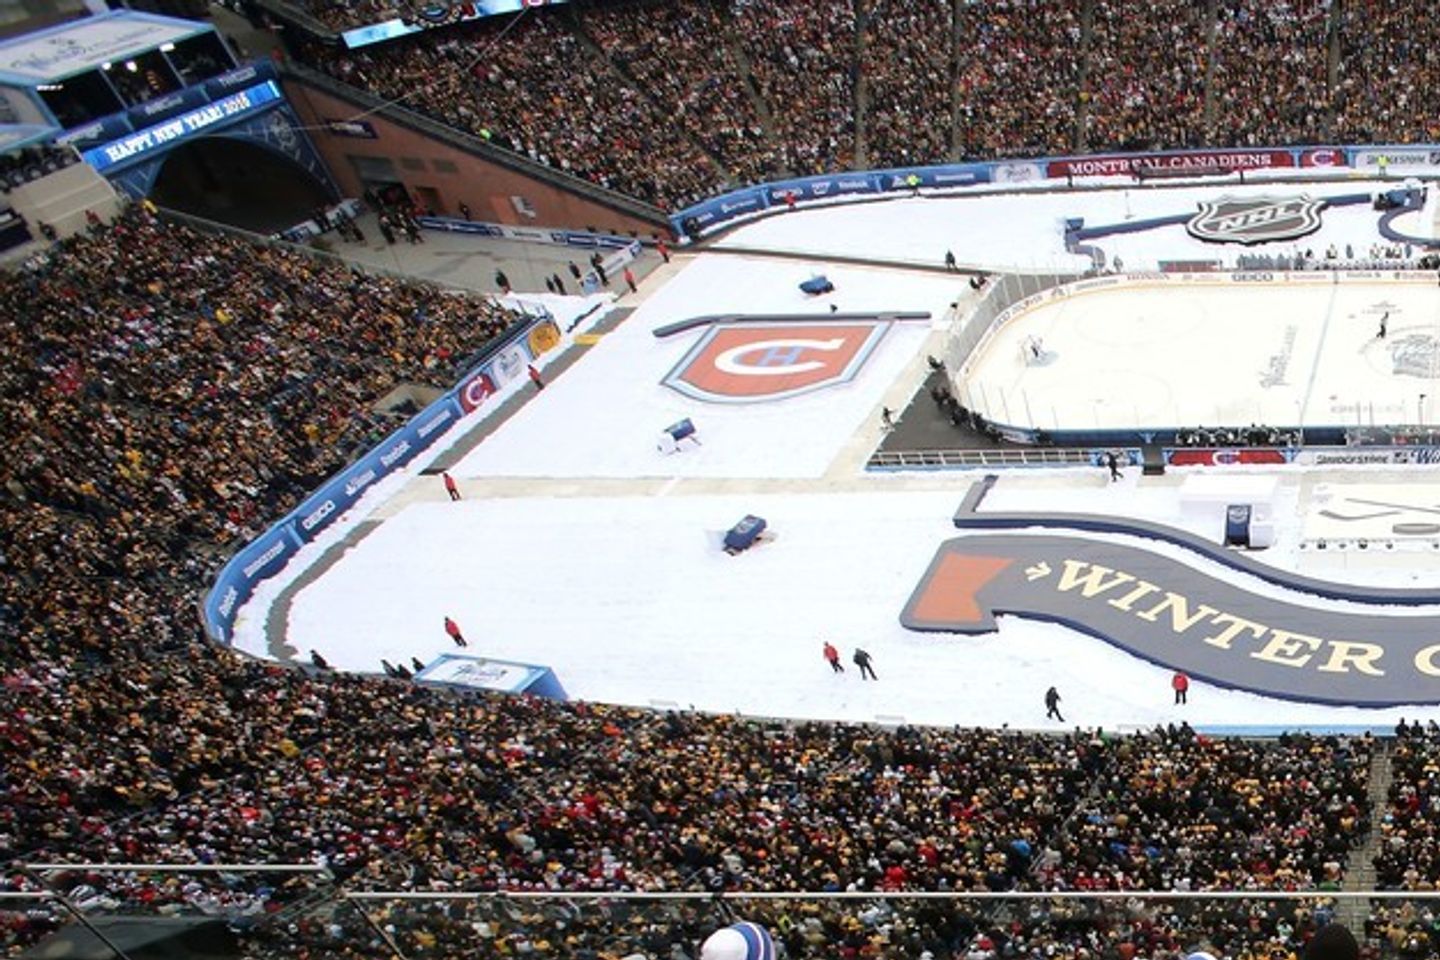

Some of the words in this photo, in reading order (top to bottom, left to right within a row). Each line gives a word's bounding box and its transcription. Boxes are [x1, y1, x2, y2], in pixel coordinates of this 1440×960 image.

[107, 136, 154, 162] HAPPY
[154, 122, 185, 144] NEW
[185, 106, 223, 130] YEAR!
[223, 94, 251, 115] 2016
[1068, 157, 1168, 176] MONTREAL
[1169, 153, 1272, 170] CANADIENS
[1217, 204, 1301, 233] NHL
[1231, 271, 1274, 283] GEICO
[1316, 454, 1389, 465] BRIDGESTONE
[1055, 558, 1386, 678] WINTER
